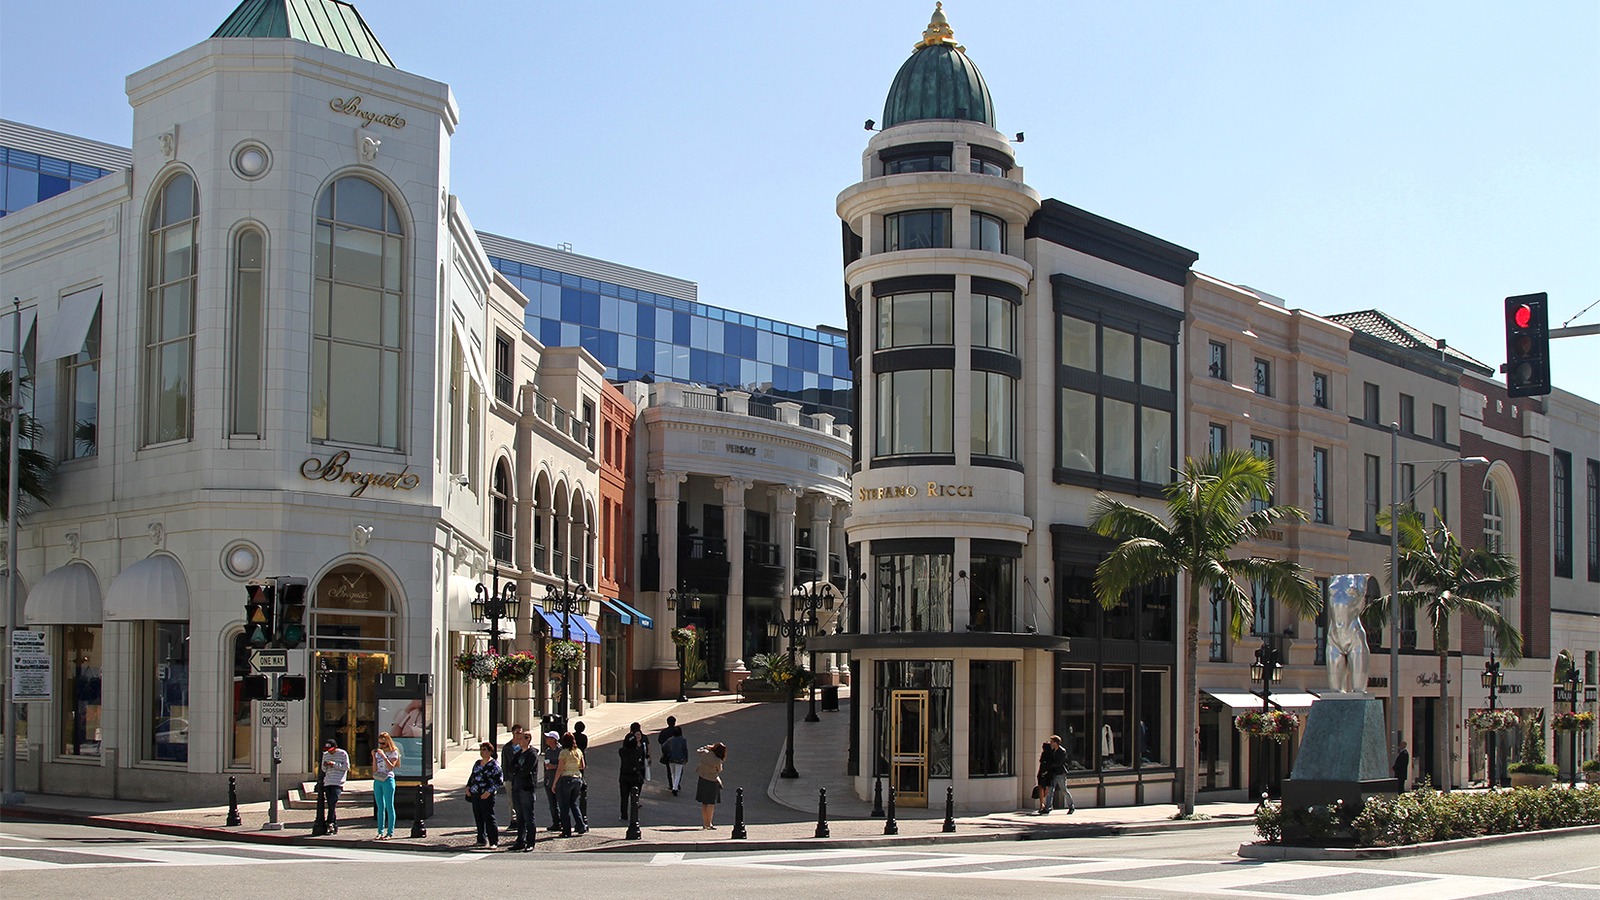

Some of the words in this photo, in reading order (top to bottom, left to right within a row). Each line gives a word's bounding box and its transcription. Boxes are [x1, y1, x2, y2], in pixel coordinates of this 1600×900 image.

[329, 96, 407, 129] Breguet
[725, 443, 757, 456] VERSACE
[300, 450, 420, 498] Breguet
[859, 486, 918, 502] STEFANO
[927, 481, 974, 497] RICCI
[261, 656, 272, 665] ONE
[273, 656, 284, 665] WAY
[262, 716, 272, 725] OK
